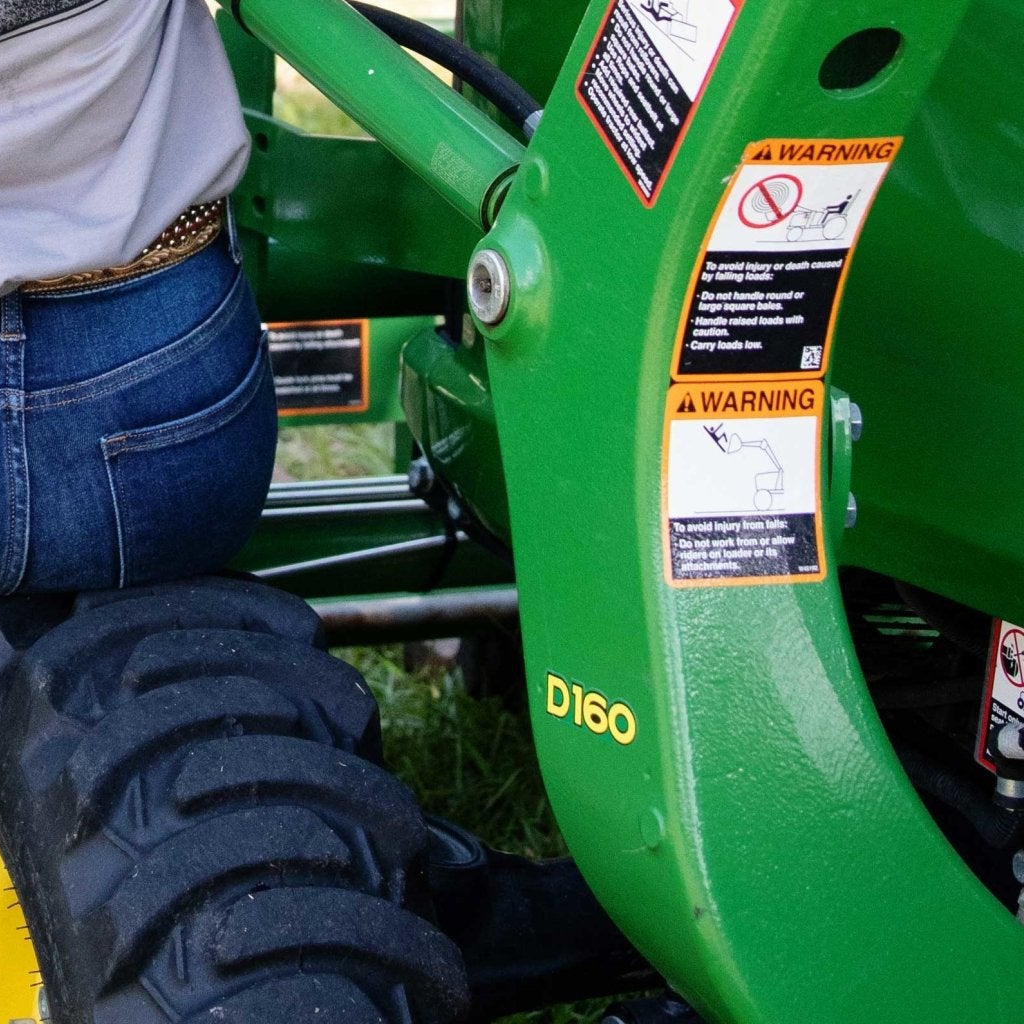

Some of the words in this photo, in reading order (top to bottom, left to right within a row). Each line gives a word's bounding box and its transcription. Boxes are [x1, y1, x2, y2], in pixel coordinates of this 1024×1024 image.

[779, 142, 894, 161] WARNING
[706, 262, 716, 270] To
[718, 262, 744, 271] avoid
[745, 261, 771, 272] injury
[785, 261, 809, 270] death
[811, 259, 843, 269] caused
[701, 272, 713, 282] by
[715, 272, 744, 283] falling
[745, 272, 774, 281] loads:
[701, 292, 714, 300] Do
[716, 292, 732, 300] not
[733, 291, 764, 300] handle
[766, 291, 792, 300] round
[698, 302, 722, 312] large
[724, 302, 755, 312] square
[757, 302, 783, 311] bales.
[695, 316, 727, 326] Handle
[729, 316, 757, 325] raised
[759, 316, 784, 325] loads
[785, 315, 804, 324] with
[693, 327, 729, 336] caution.
[691, 341, 716, 351] Carry
[718, 341, 743, 349] loads
[745, 341, 762, 349] low.
[701, 388, 815, 412] WARNING
[674, 522, 685, 532] To
[687, 521, 712, 532] avoid
[715, 521, 740, 533] injury
[742, 521, 764, 529] from
[766, 520, 787, 529] falls:
[679, 538, 692, 548] Do
[694, 539, 710, 548] not
[712, 538, 734, 547] work
[736, 537, 758, 546] from
[771, 536, 795, 545] allow
[680, 548, 707, 559] riders
[709, 550, 721, 558] on
[723, 547, 752, 557] loader
[754, 548, 764, 557] or
[765, 547, 777, 556] its
[681, 562, 740, 571] attachments.
[546, 672, 636, 746] D160
